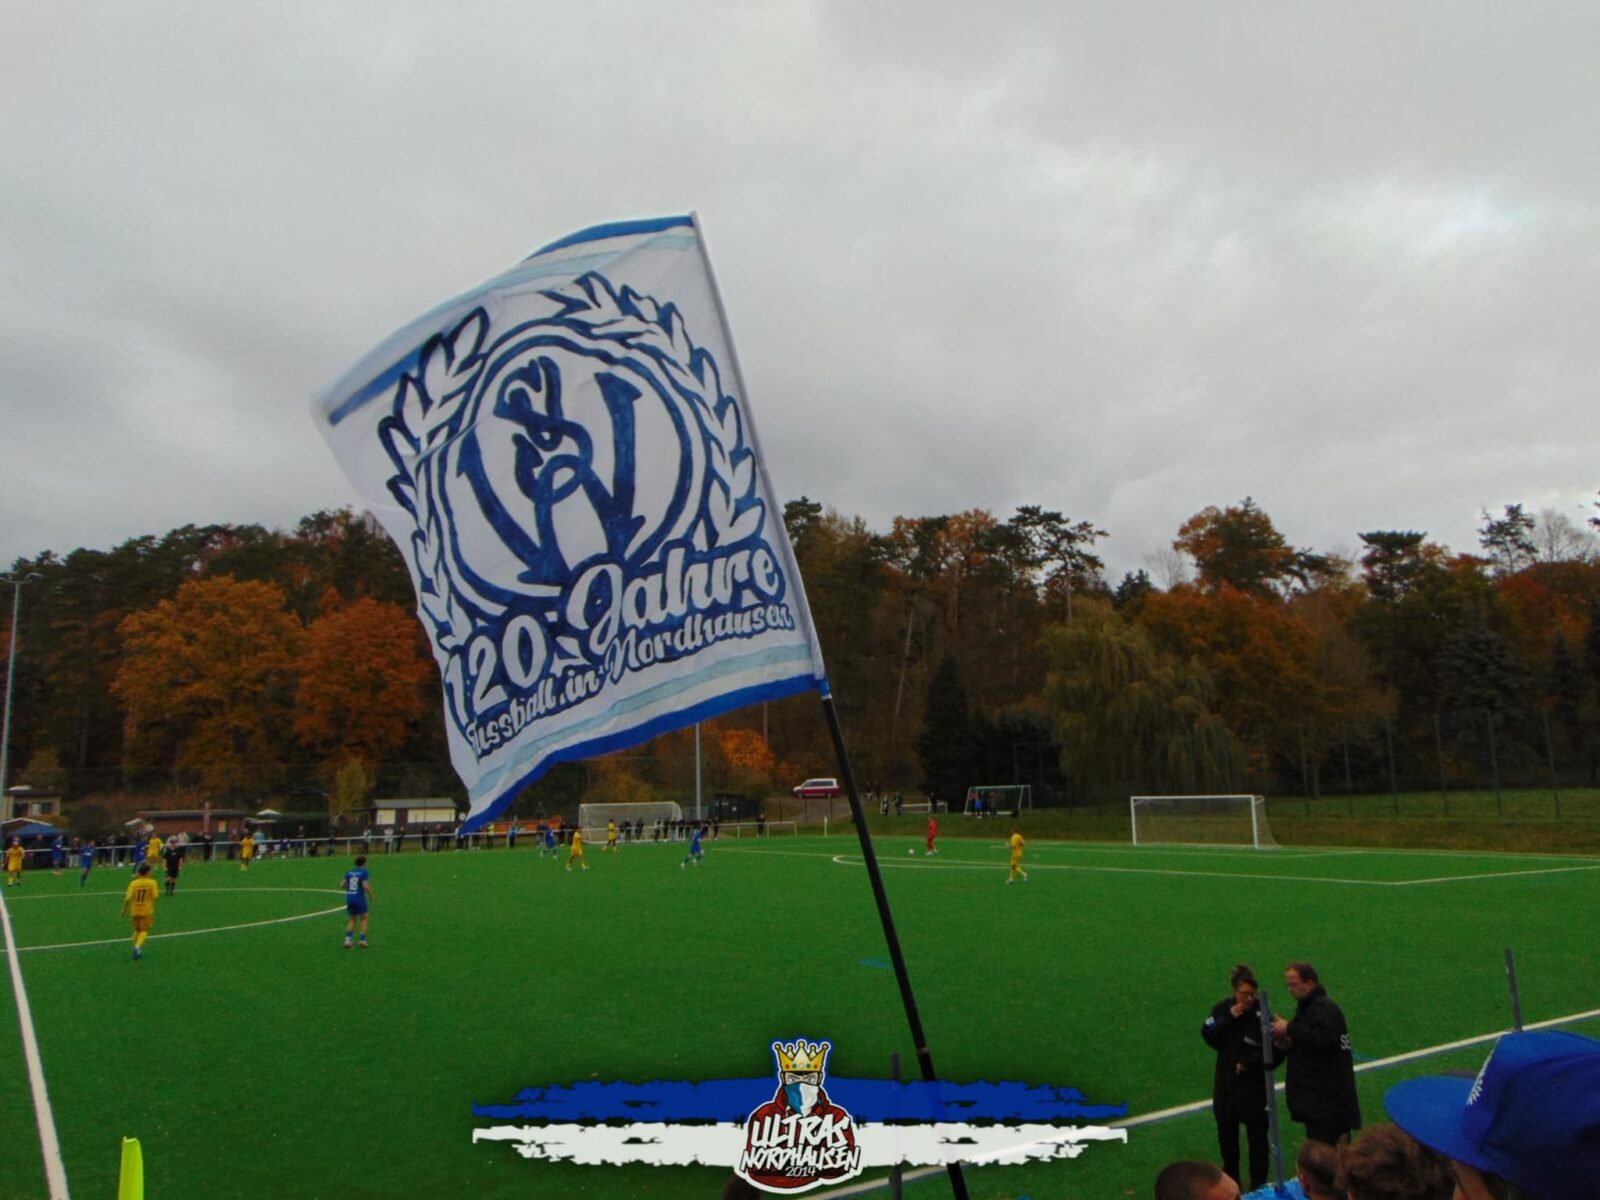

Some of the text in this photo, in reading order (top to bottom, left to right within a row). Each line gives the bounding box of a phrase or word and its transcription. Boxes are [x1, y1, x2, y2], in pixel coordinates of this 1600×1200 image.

[445, 546, 779, 727] 120 Jahre
[466, 606, 792, 760] Fussball in Nordhausen
